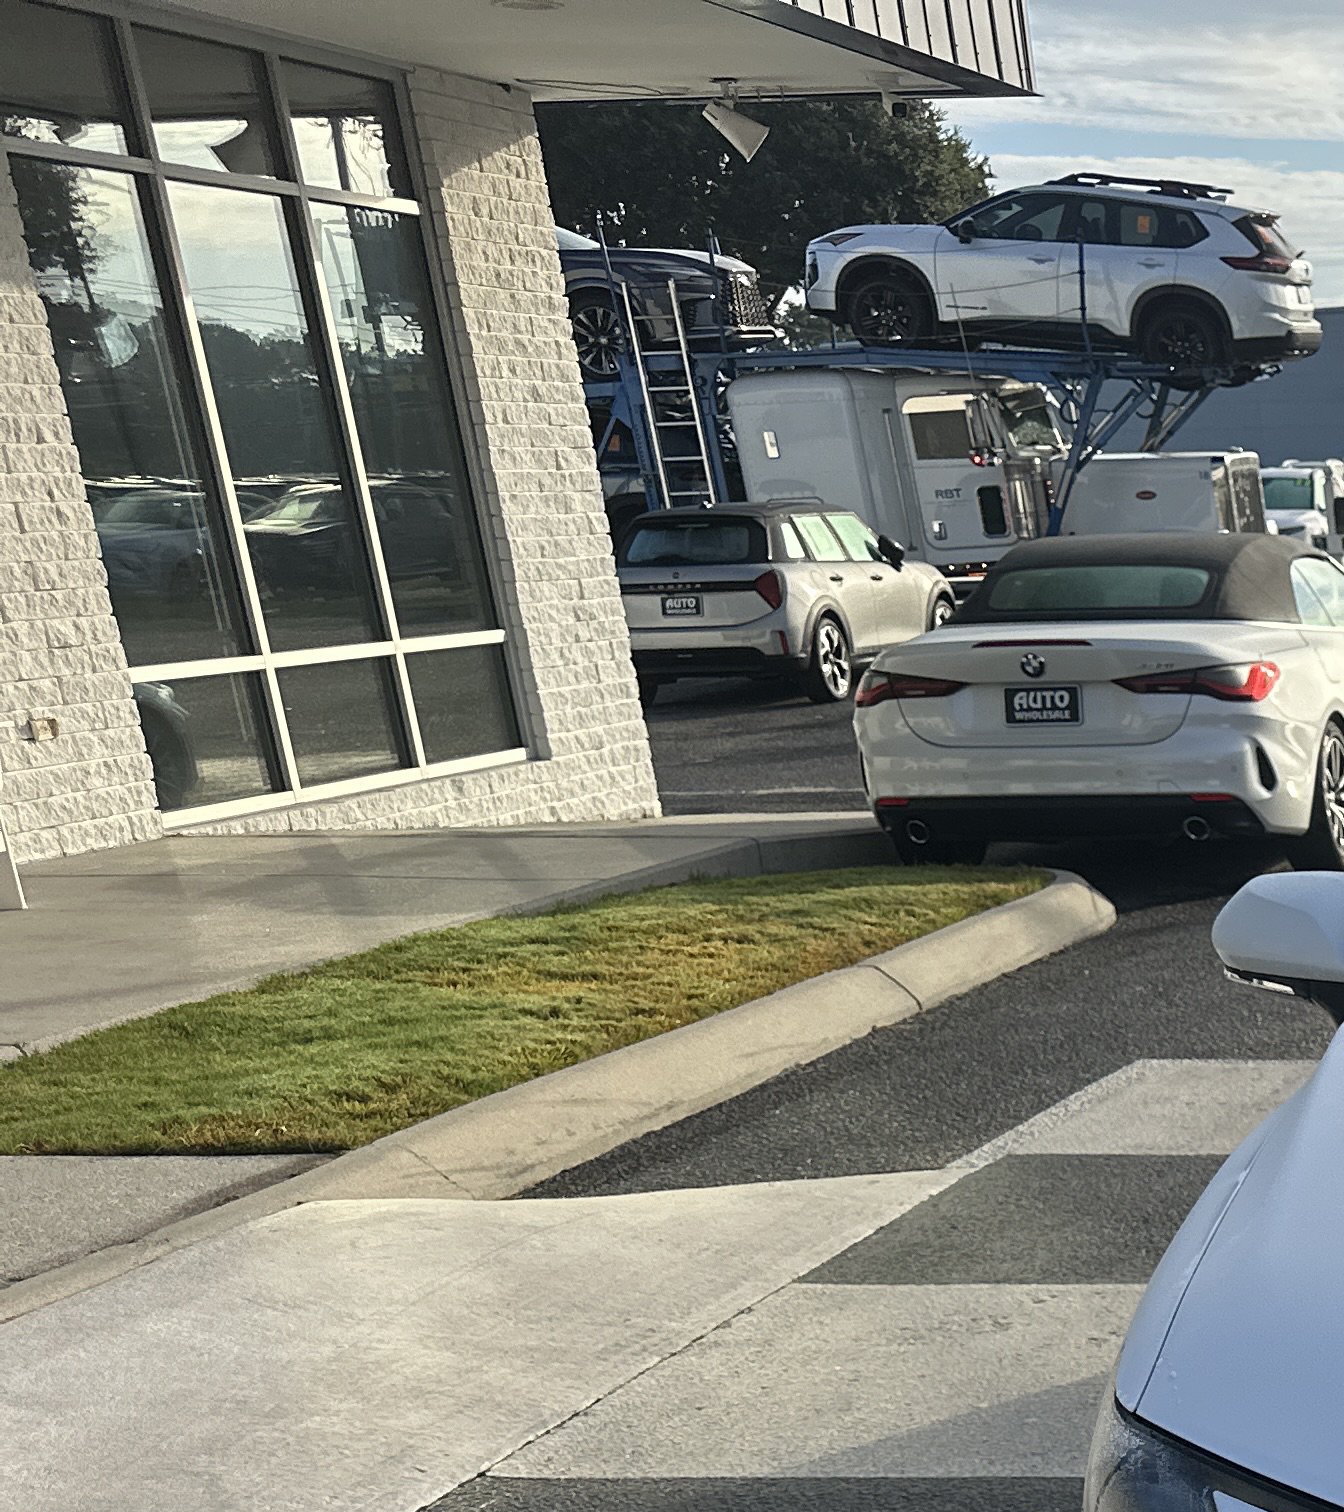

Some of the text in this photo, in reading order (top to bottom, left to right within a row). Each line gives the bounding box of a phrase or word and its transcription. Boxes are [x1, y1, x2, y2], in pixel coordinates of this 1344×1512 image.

[666, 598, 696, 609] AUTO
[1013, 690, 1070, 711] AUTO
[1015, 710, 1072, 721] WHOLESALE
